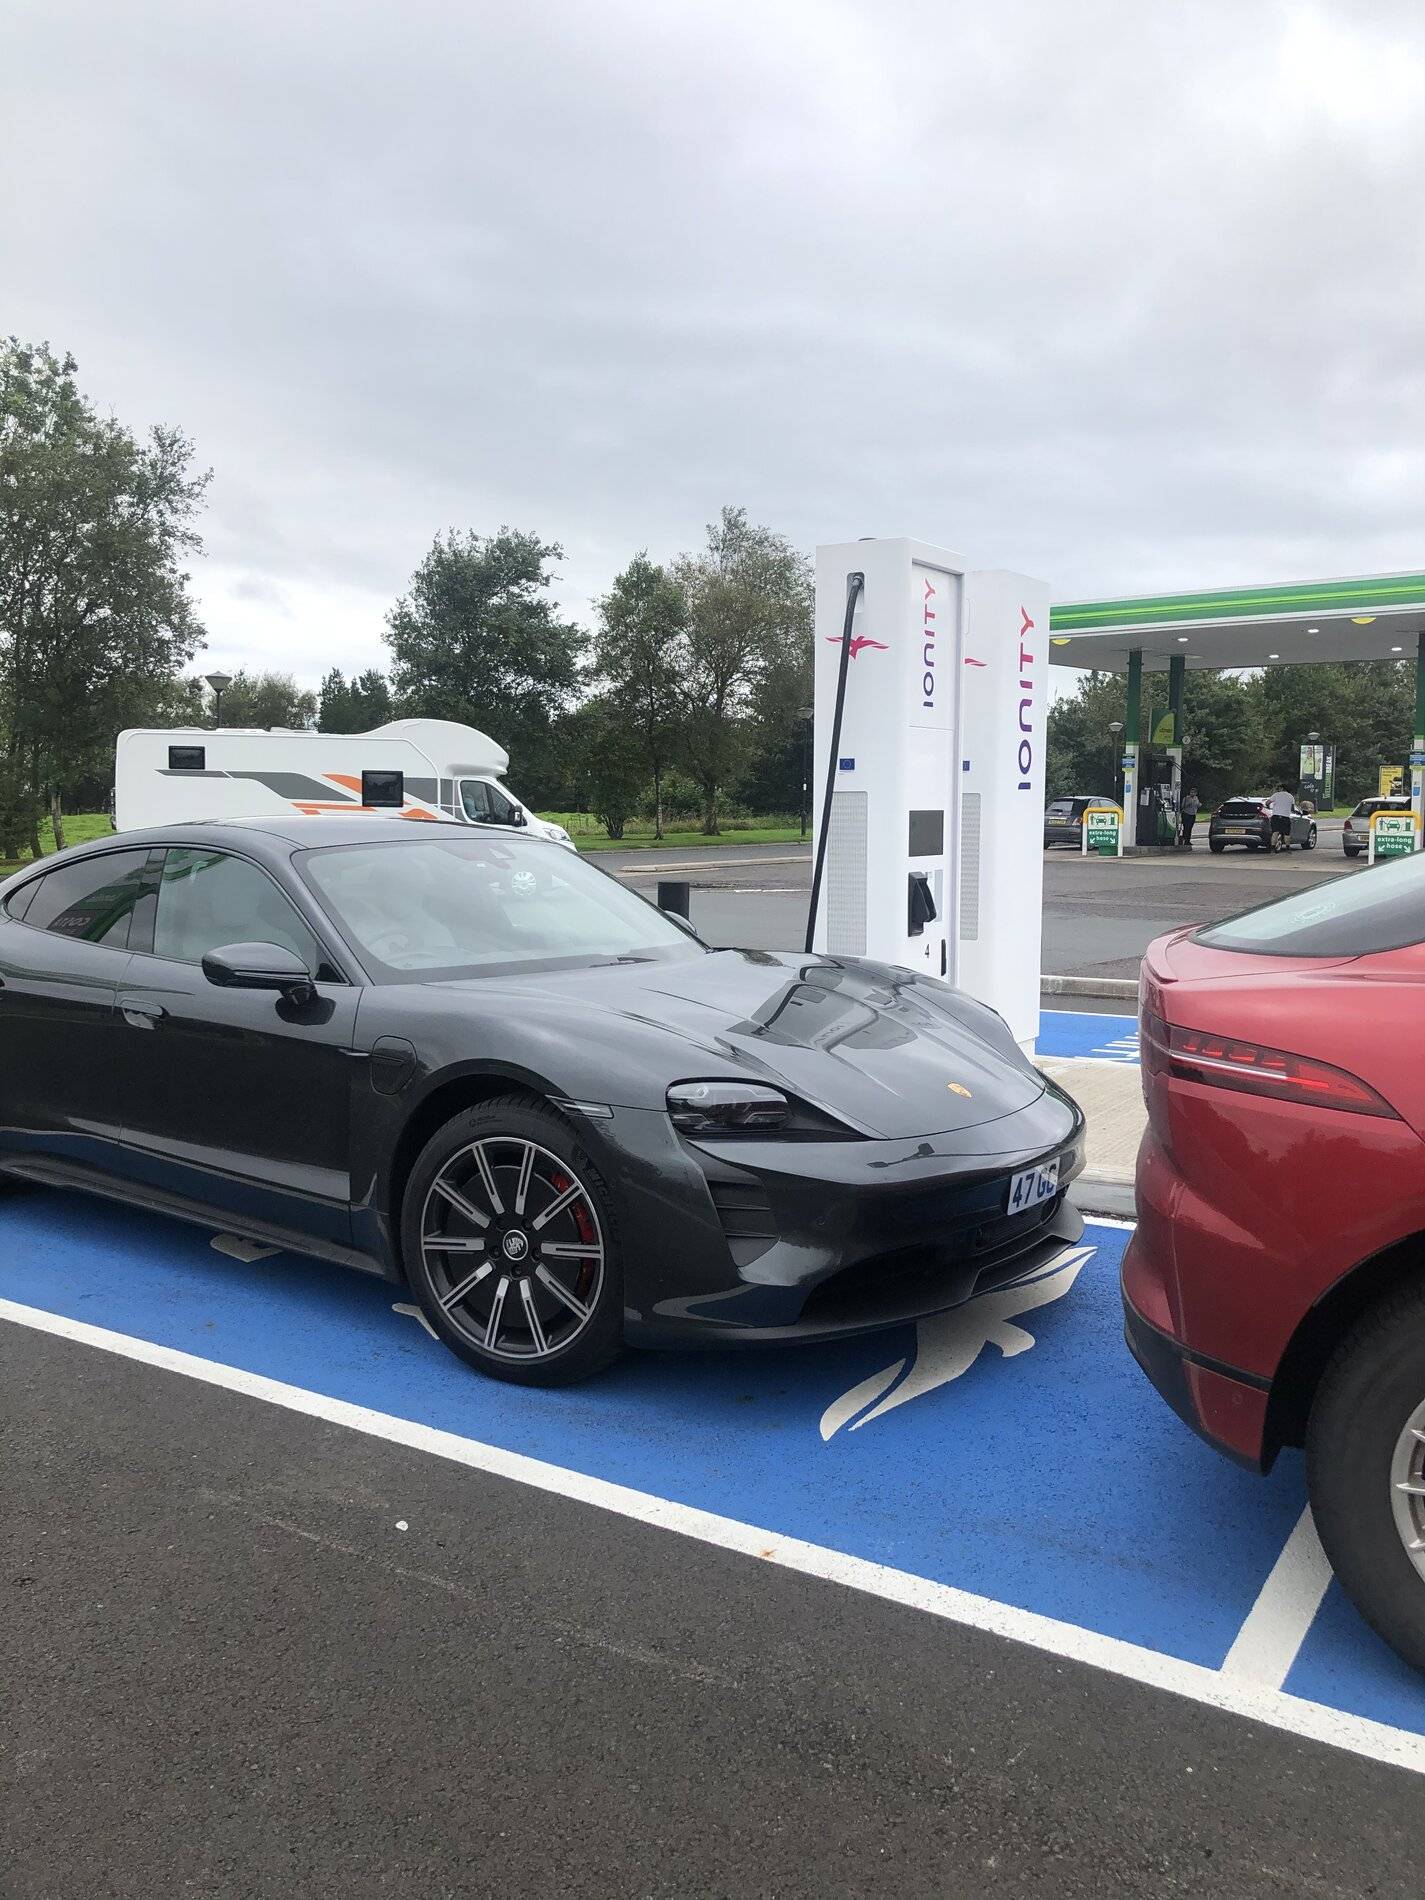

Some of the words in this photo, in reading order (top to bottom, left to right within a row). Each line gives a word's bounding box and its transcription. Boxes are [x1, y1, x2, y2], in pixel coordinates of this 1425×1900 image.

[923, 577, 936, 707] IONITY
[1018, 606, 1034, 790] IONITY
[1377, 836, 1412, 844] extra-long
[924, 943, 930, 958] 4
[1012, 1172, 1035, 1208] 47
